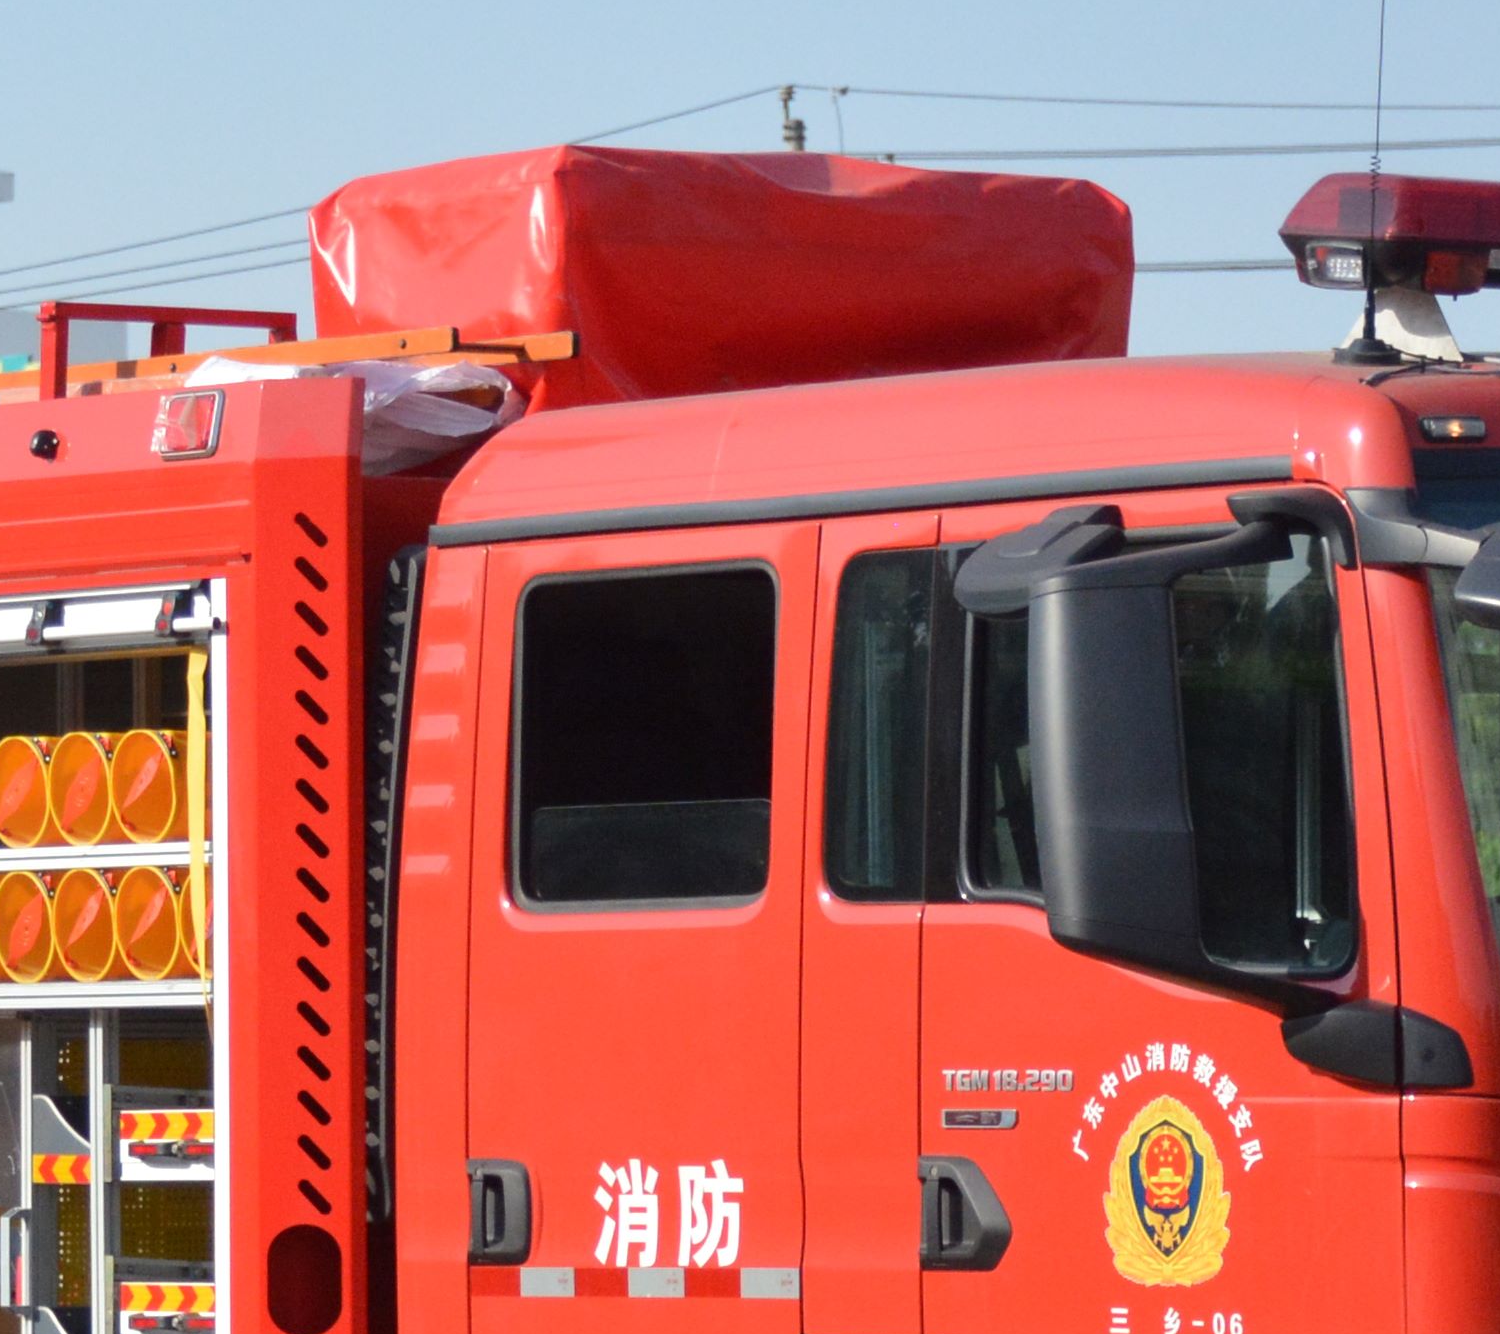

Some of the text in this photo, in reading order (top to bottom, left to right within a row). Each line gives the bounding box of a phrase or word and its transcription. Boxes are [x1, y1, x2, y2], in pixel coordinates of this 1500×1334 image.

[942, 1069, 1074, 1091] TGM 18.290
[1071, 1042, 1264, 1172] 广东中山消防救援支队
[593, 1158, 744, 1268] 消防
